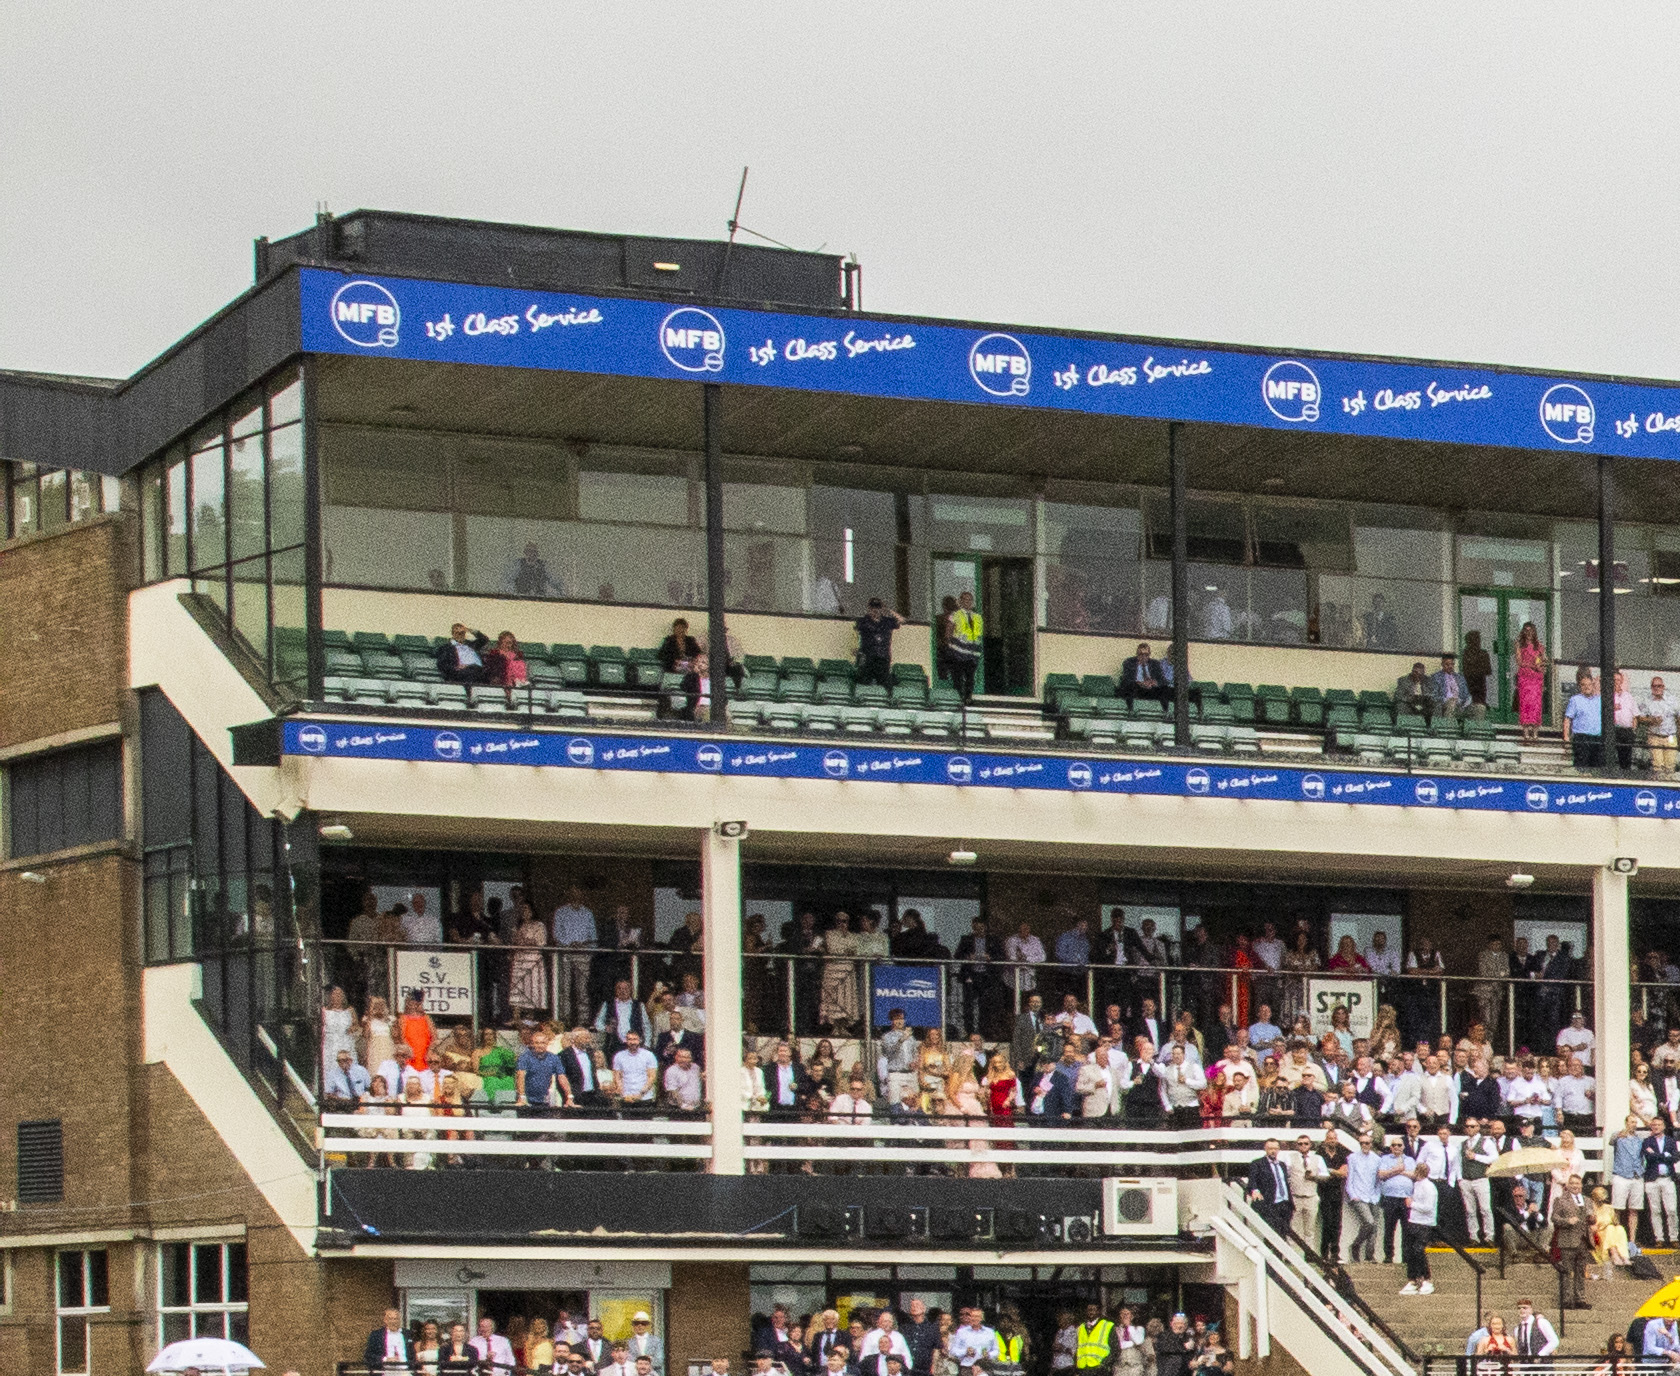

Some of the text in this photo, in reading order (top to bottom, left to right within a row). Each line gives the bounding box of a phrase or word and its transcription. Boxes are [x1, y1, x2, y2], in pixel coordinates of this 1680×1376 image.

[337, 301, 603, 341] MFB 1st Class Service
[665, 327, 916, 366] MFB 1st Class Service
[975, 352, 1212, 390] MFB 1st Class Service
[1267, 379, 1492, 416] MFB 1st Class Service
[1544, 402, 1591, 424] MFB
[1615, 413, 1639, 439] 1st
[875, 987, 938, 999] MALONE
[1316, 988, 1362, 1014] STP
